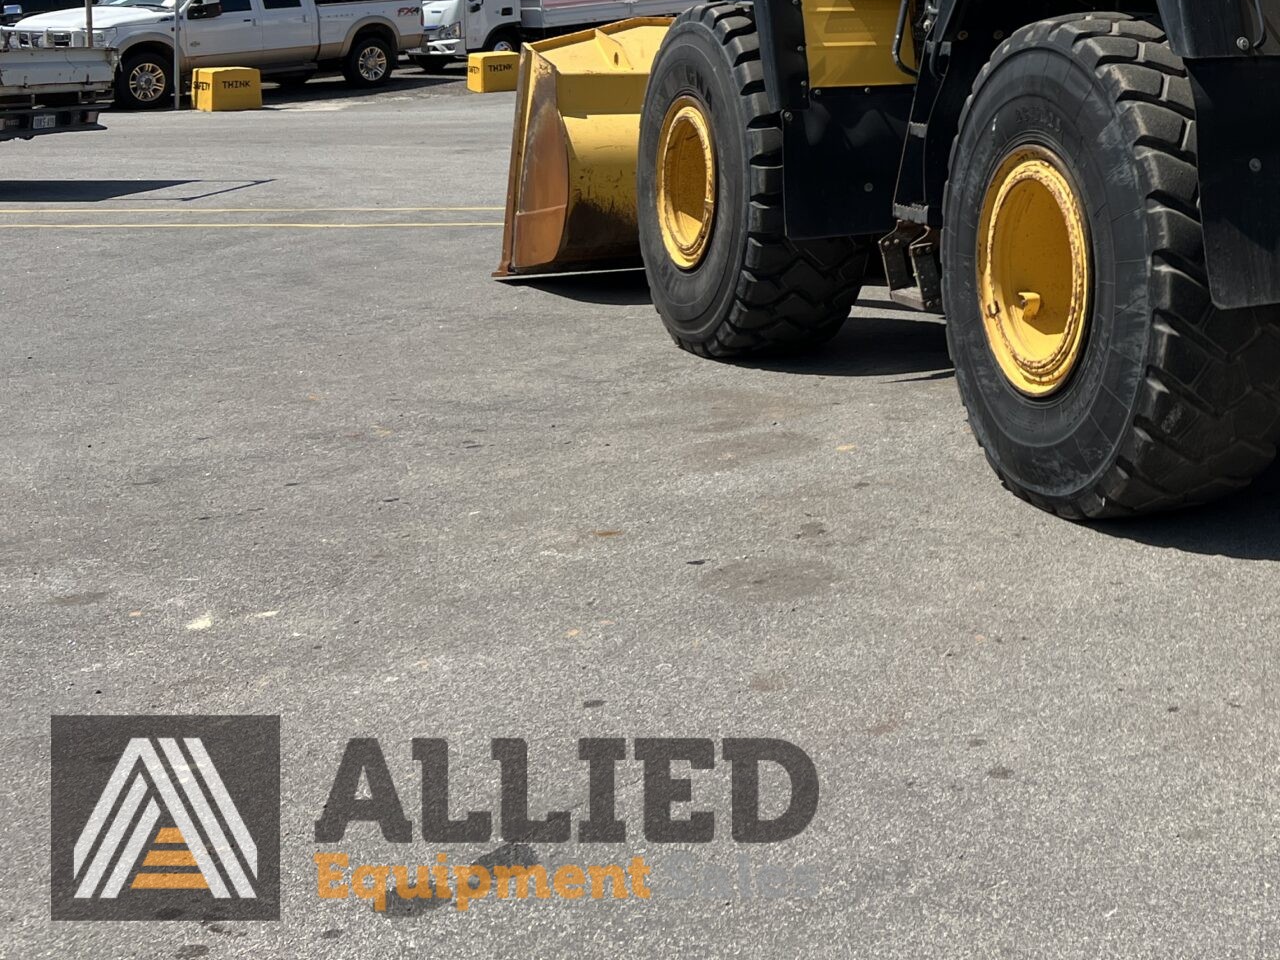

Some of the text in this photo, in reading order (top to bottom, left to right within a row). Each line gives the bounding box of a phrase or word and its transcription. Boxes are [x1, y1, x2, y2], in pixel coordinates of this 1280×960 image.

[397, 7, 420, 17] FX4
[488, 63, 513, 72] THINK
[222, 80, 251, 89] THINK
